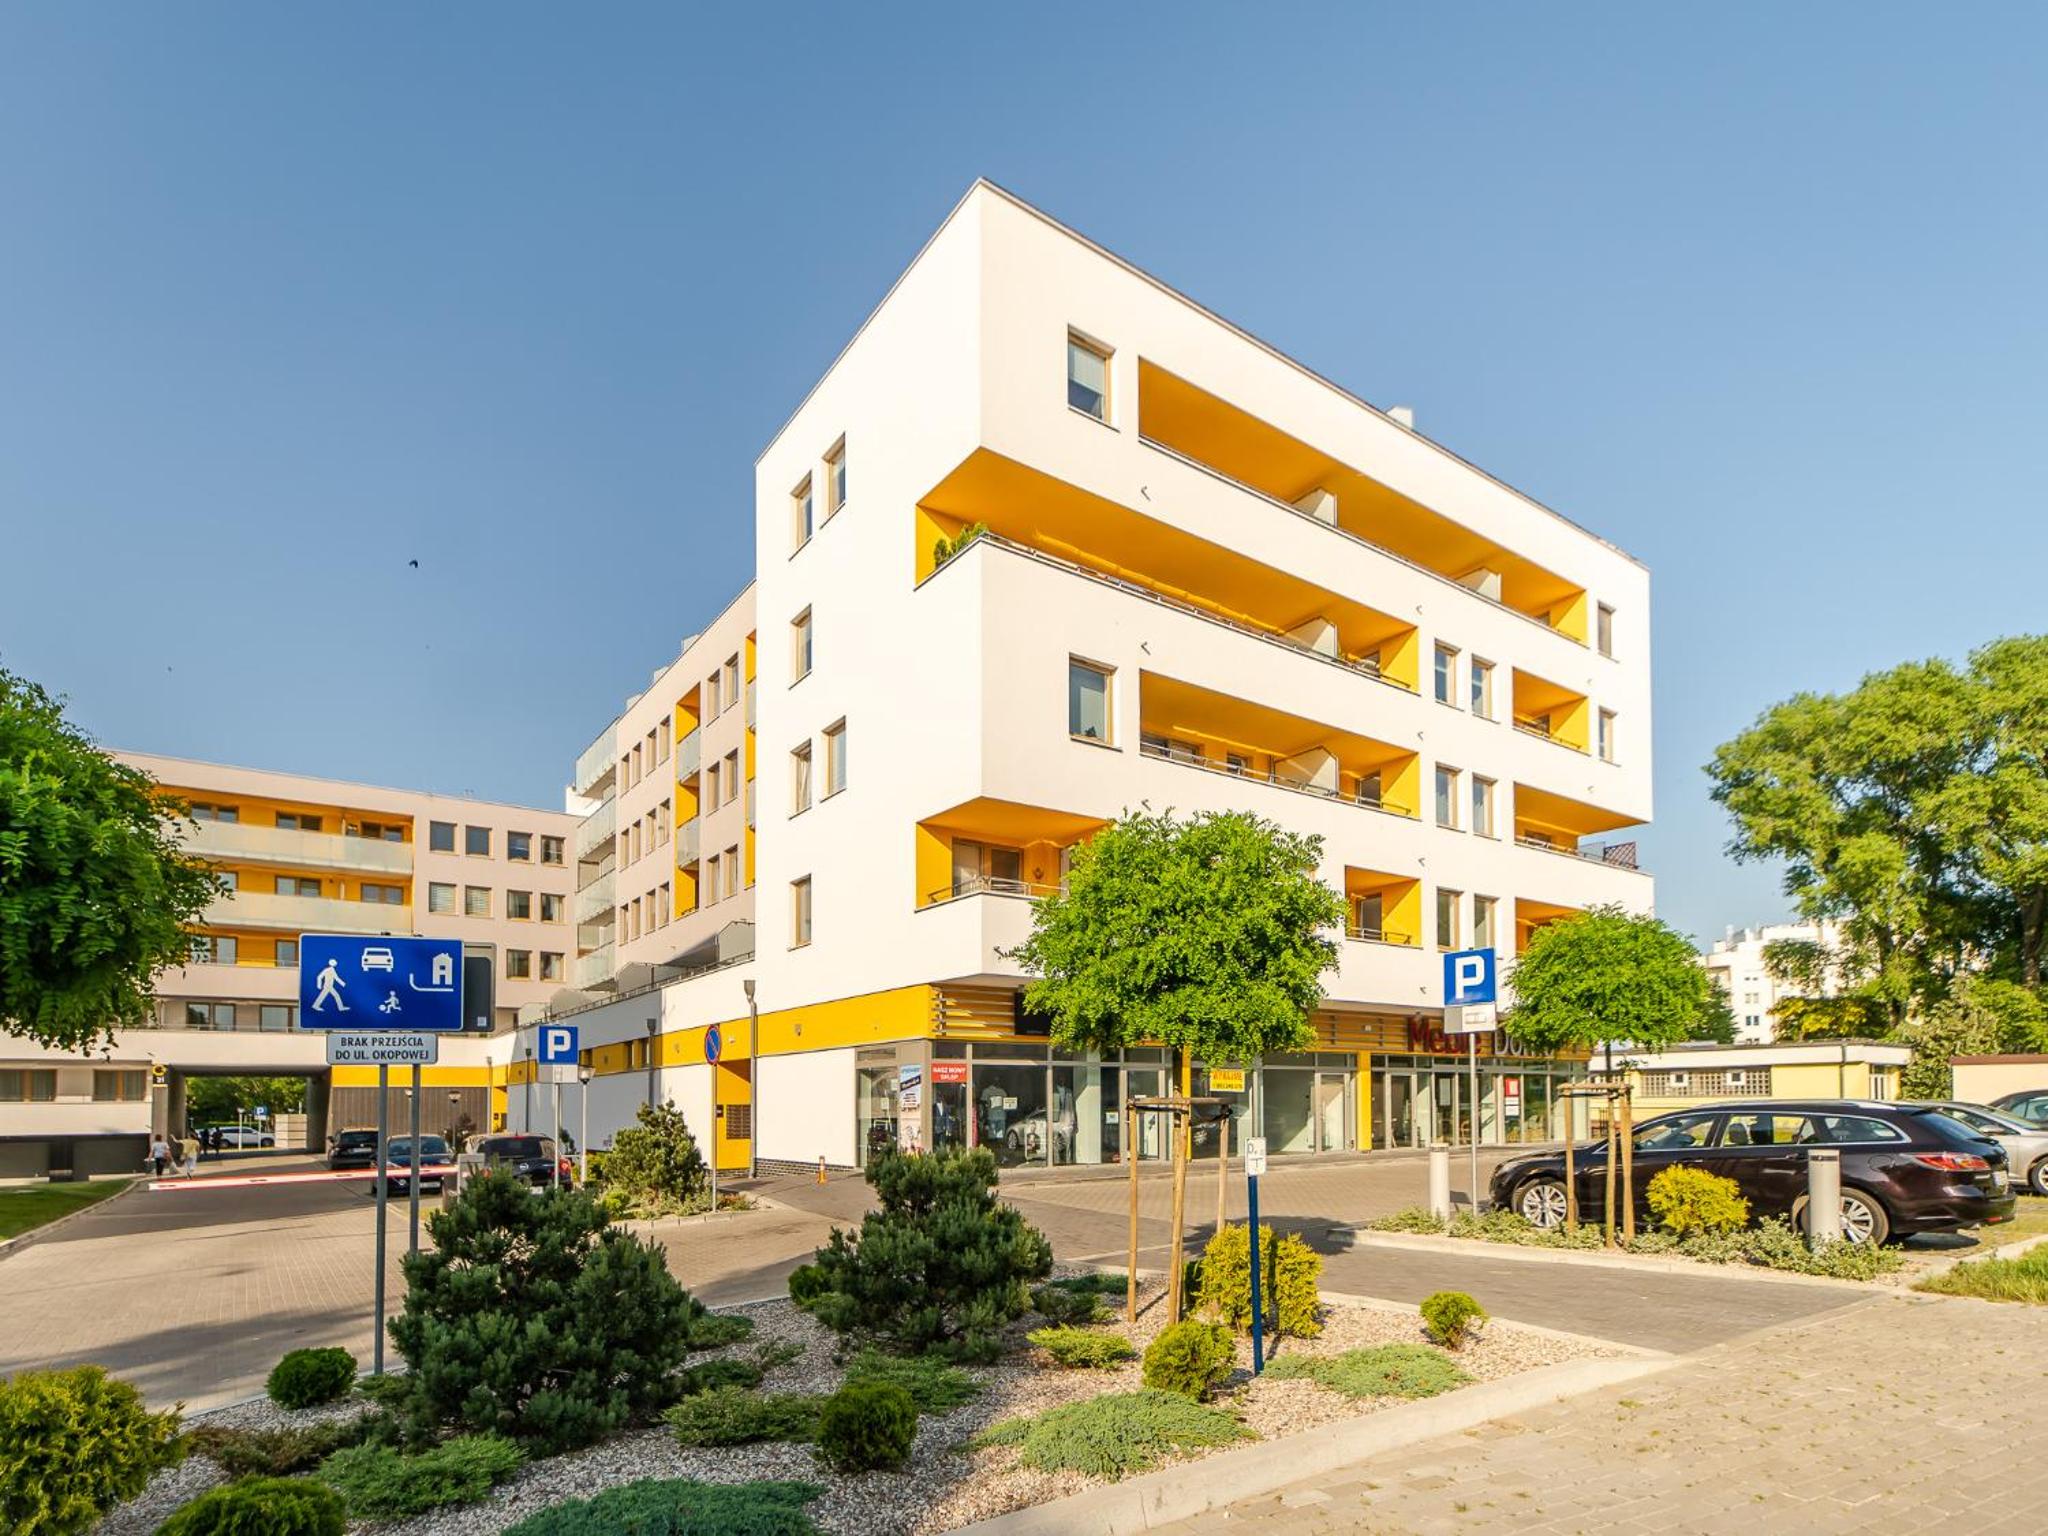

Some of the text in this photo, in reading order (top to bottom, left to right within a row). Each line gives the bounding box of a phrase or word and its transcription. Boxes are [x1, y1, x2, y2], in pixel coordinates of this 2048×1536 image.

[1455, 955, 1485, 999] P
[341, 1035, 424, 1047] BRAK PRZEJŚCIA
[547, 1030, 571, 1060] P
[335, 1050, 429, 1060] DO UL. OKOPOWEJ
